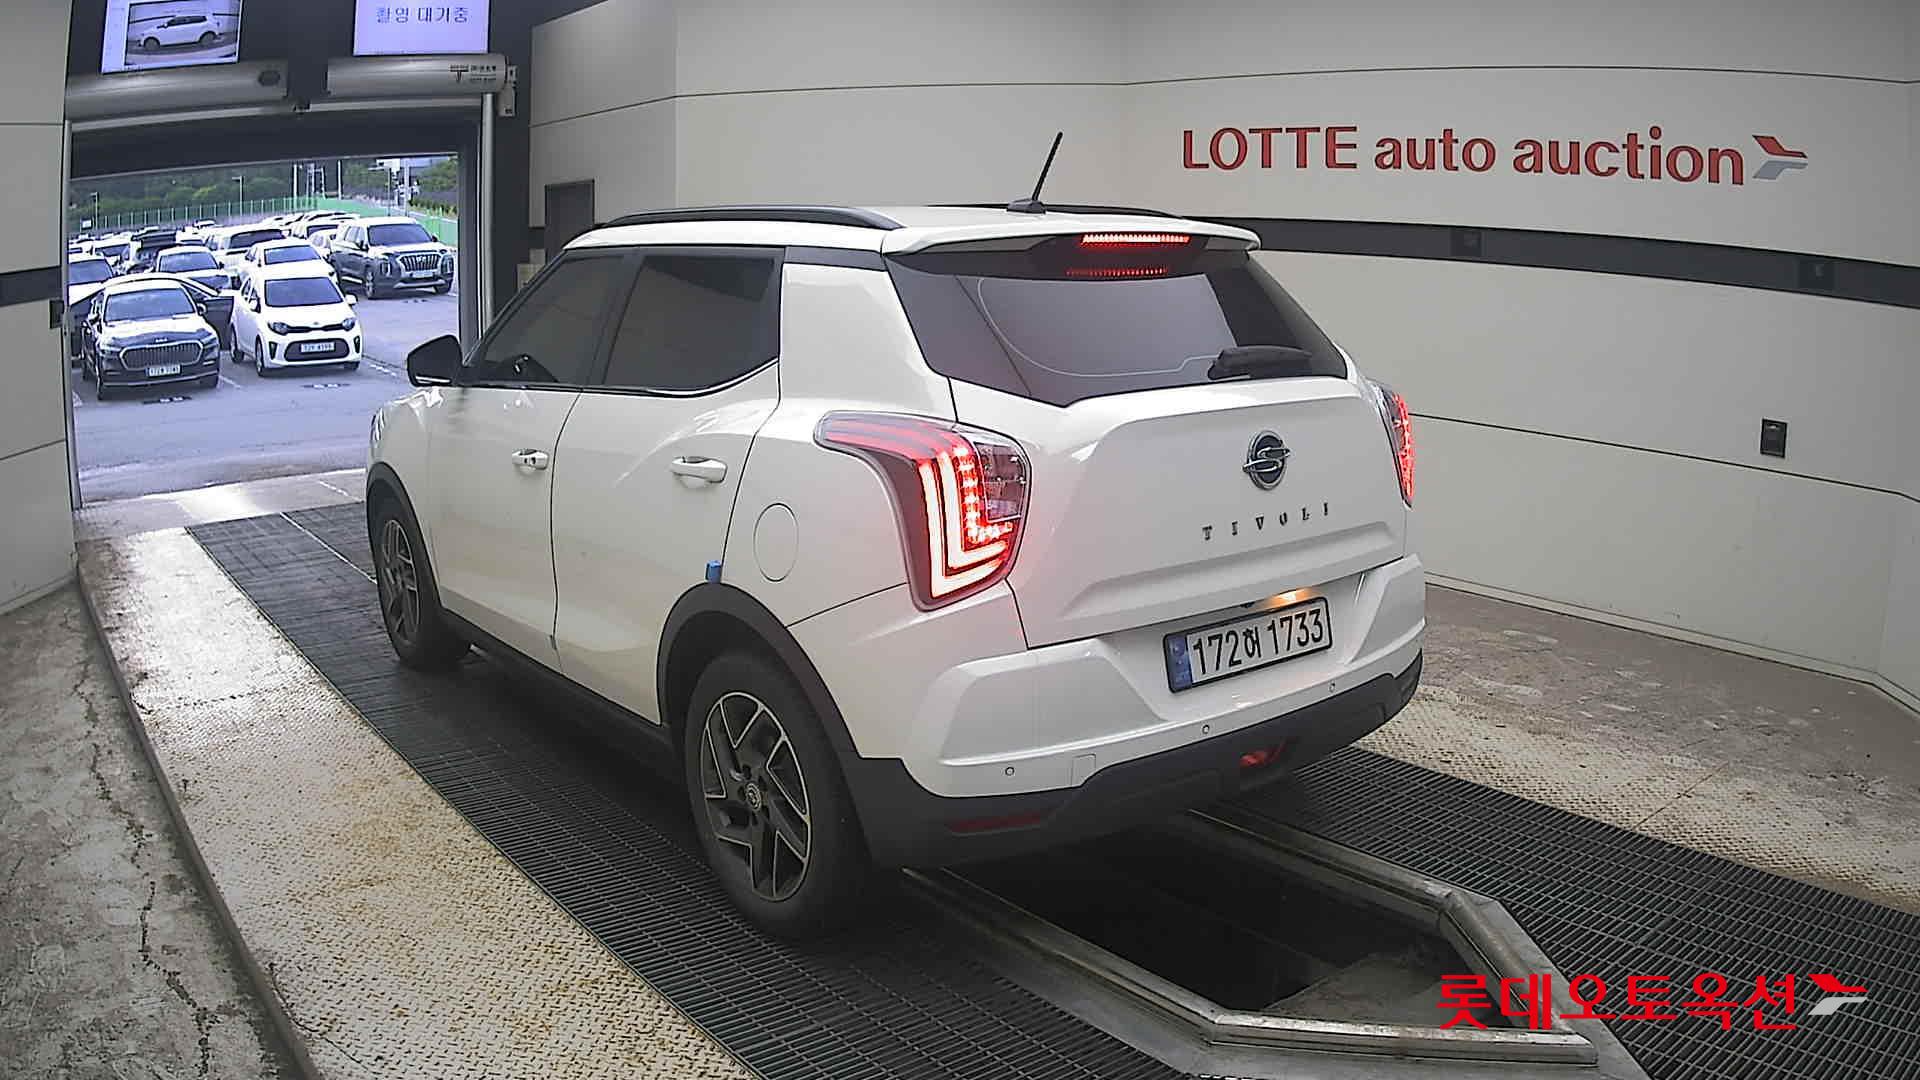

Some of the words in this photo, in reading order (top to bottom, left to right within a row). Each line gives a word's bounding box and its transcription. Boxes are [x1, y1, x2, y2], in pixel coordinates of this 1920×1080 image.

[417, 7, 469, 24] 대기중
[1183, 126, 1358, 170] LOTTE
[1375, 128, 1497, 173] auto
[1512, 125, 1744, 185] auction
[1202, 502, 1330, 541] TIVOLI
[1192, 626, 1262, 675] 172허
[1267, 608, 1325, 655] 1733
